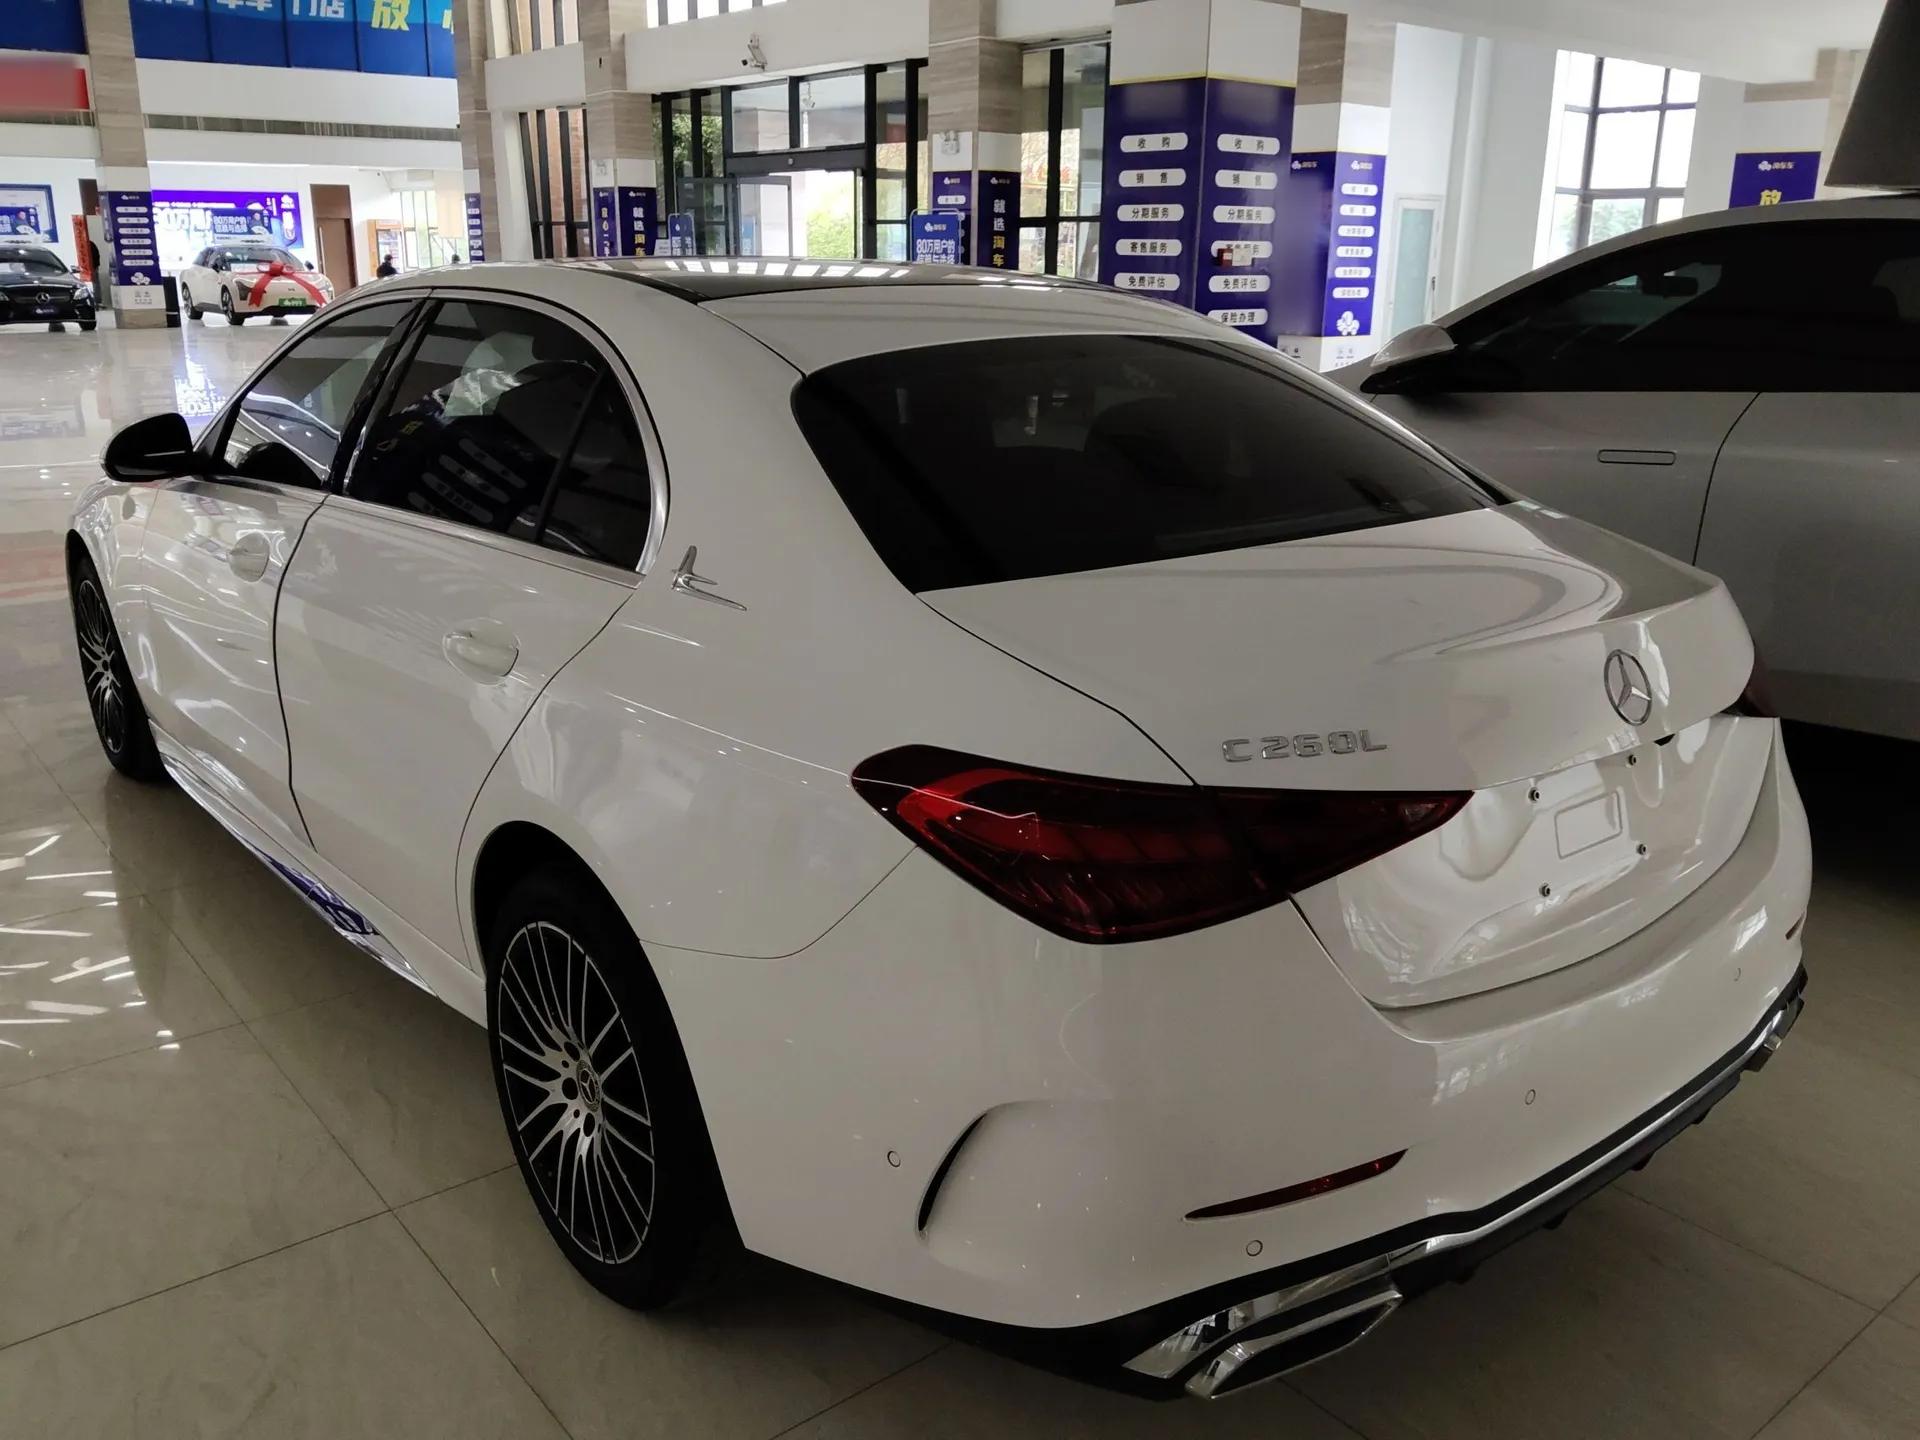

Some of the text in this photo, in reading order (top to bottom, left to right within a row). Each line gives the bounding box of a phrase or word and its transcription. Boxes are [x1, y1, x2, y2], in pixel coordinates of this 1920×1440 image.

[1137, 136, 1171, 149] 收购
[1131, 207, 1170, 219] 分期服务
[1227, 209, 1263, 221] 分期服务
[916, 239, 956, 254] 80万用户的
[1130, 242, 1168, 254] 寄售服务
[1128, 276, 1166, 288] 免费评估
[1223, 279, 1258, 290] 免费评估
[1220, 312, 1256, 324] 保险办理
[1222, 729, 1388, 763] C 260L
